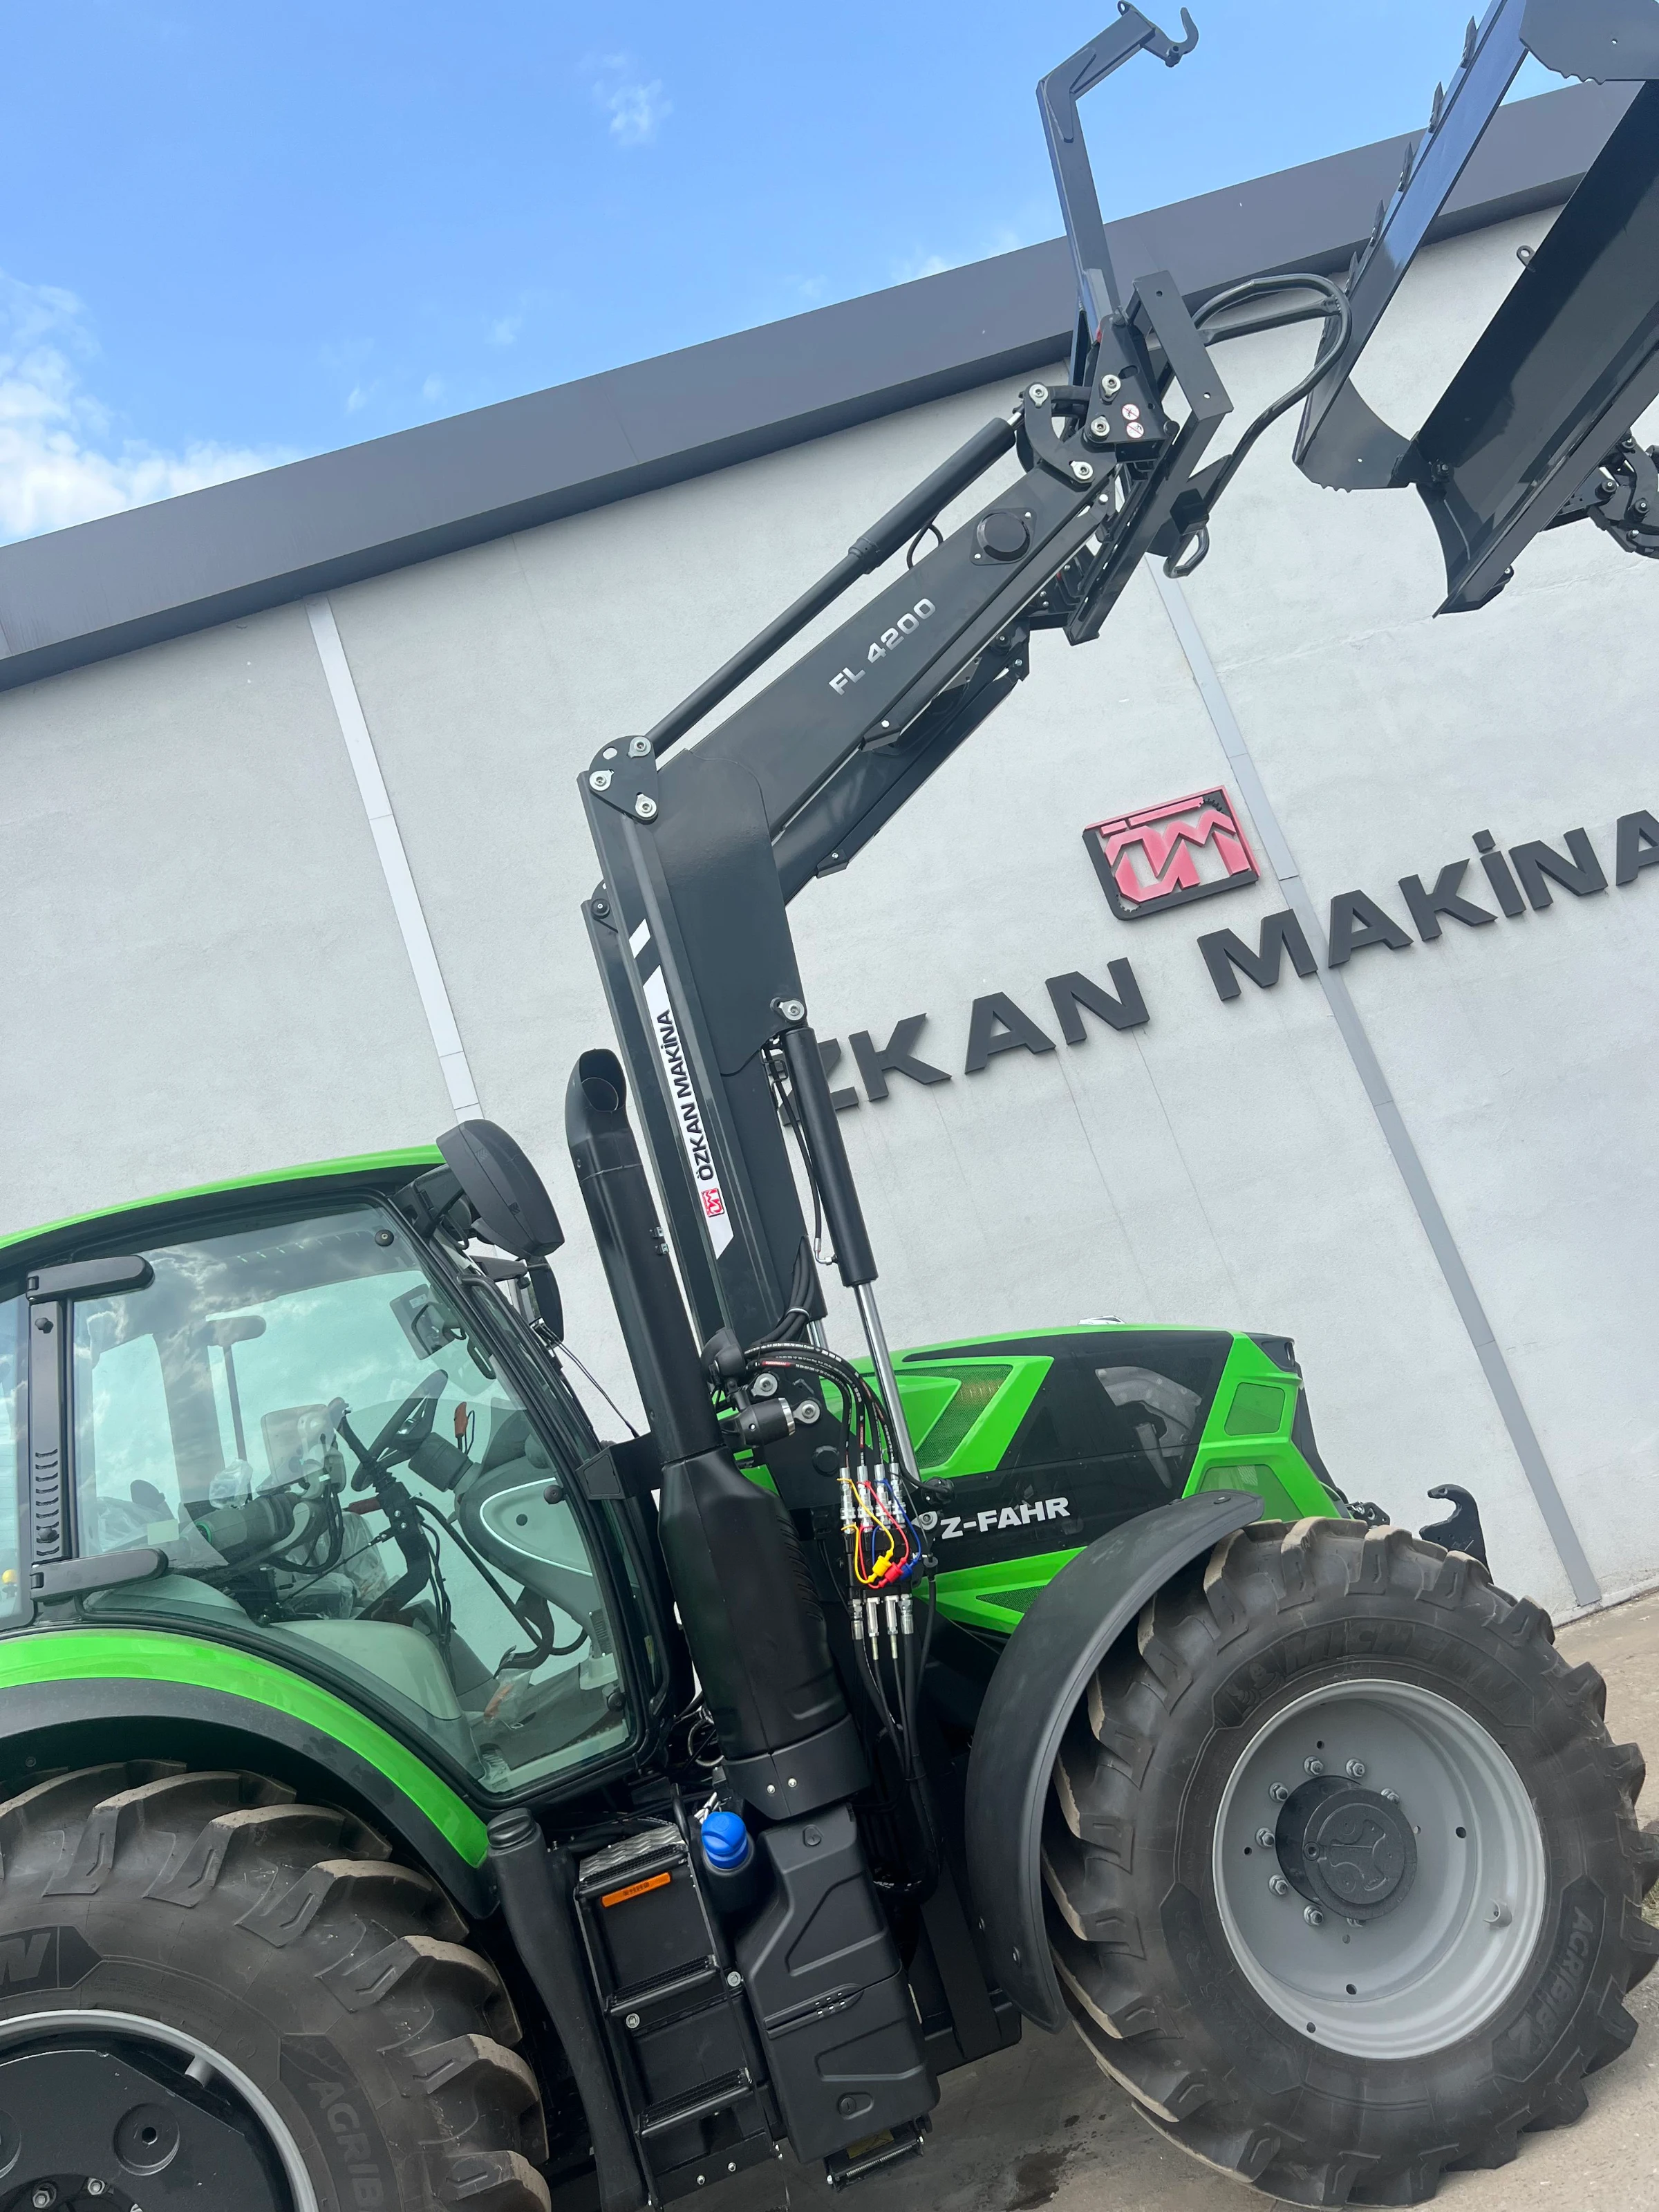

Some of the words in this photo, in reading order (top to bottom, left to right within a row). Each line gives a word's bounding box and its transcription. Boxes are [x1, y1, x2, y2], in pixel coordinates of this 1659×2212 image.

[828, 667, 865, 696] FL
[867, 598, 936, 664] 4200
[1197, 809, 1659, 1002] MAKİNA
[657, 1009, 692, 1098] MAKİNA
[680, 1102, 714, 1181] ÖZKAN
[940, 1497, 1071, 1539] Z-FAHR
[306, 2081, 387, 2212] AGRIB
